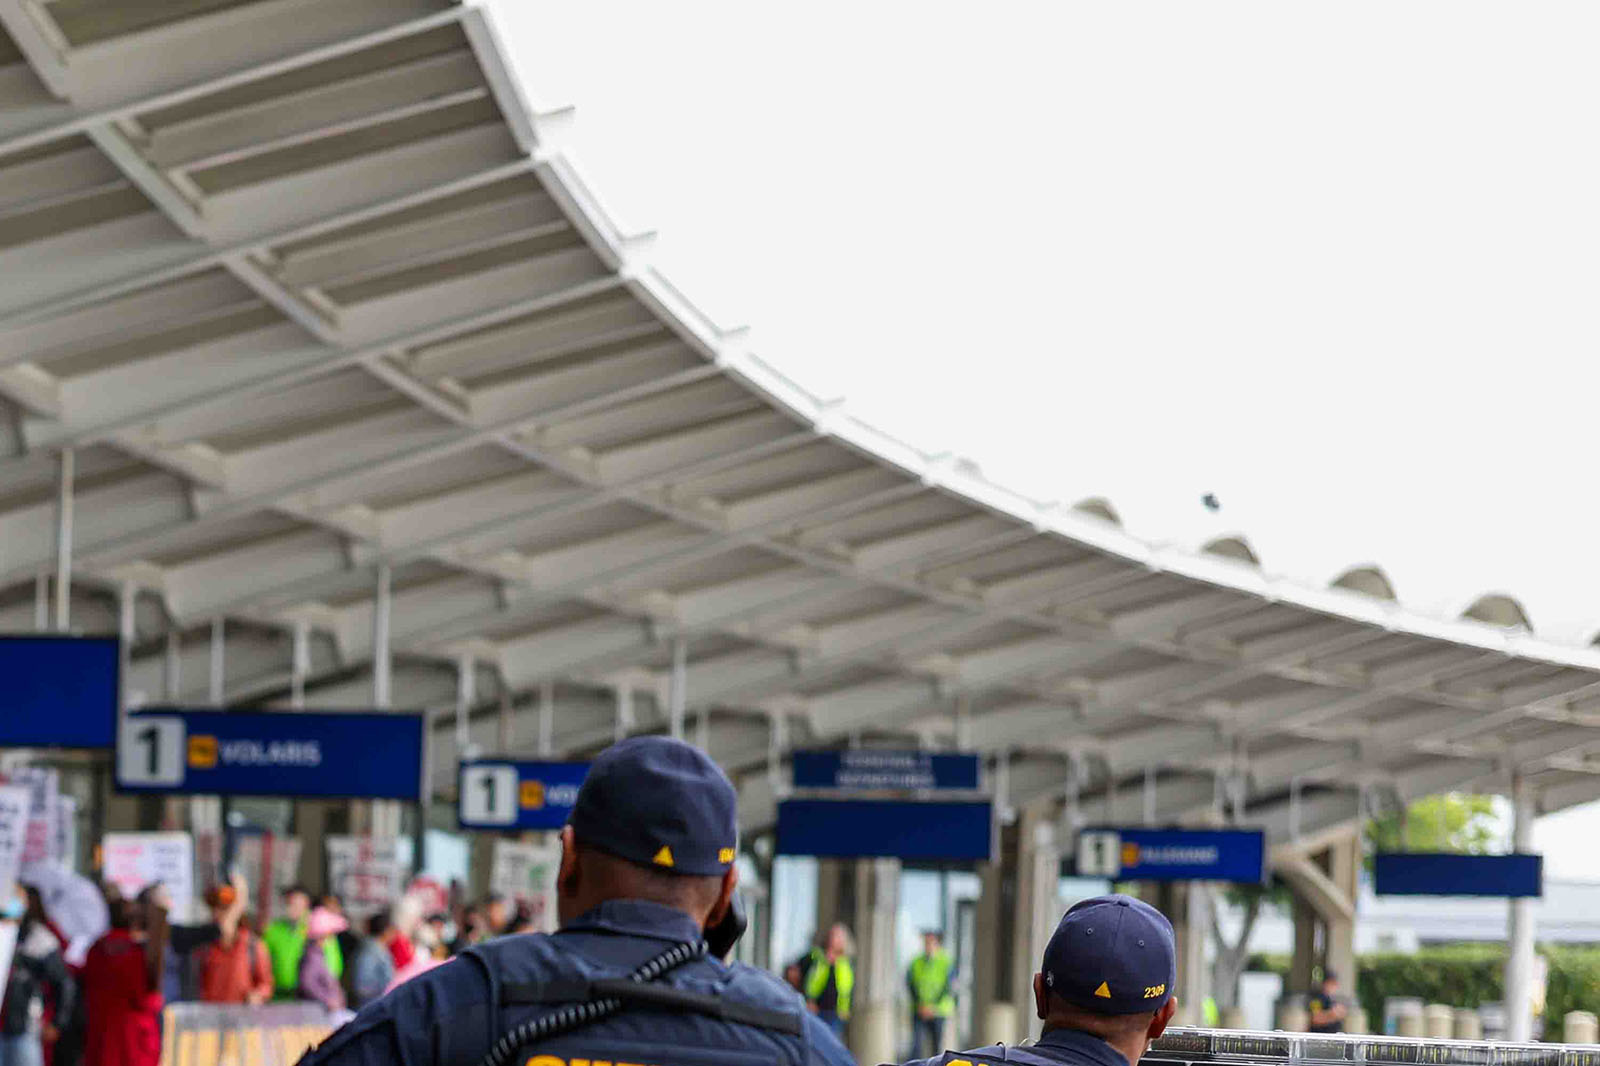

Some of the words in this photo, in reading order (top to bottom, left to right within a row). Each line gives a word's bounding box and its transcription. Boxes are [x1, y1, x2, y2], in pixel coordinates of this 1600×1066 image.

[135, 727, 162, 777] 1
[220, 741, 320, 767] VOLARIS
[478, 773, 496, 812] 1
[1143, 983, 1166, 999] 2309
